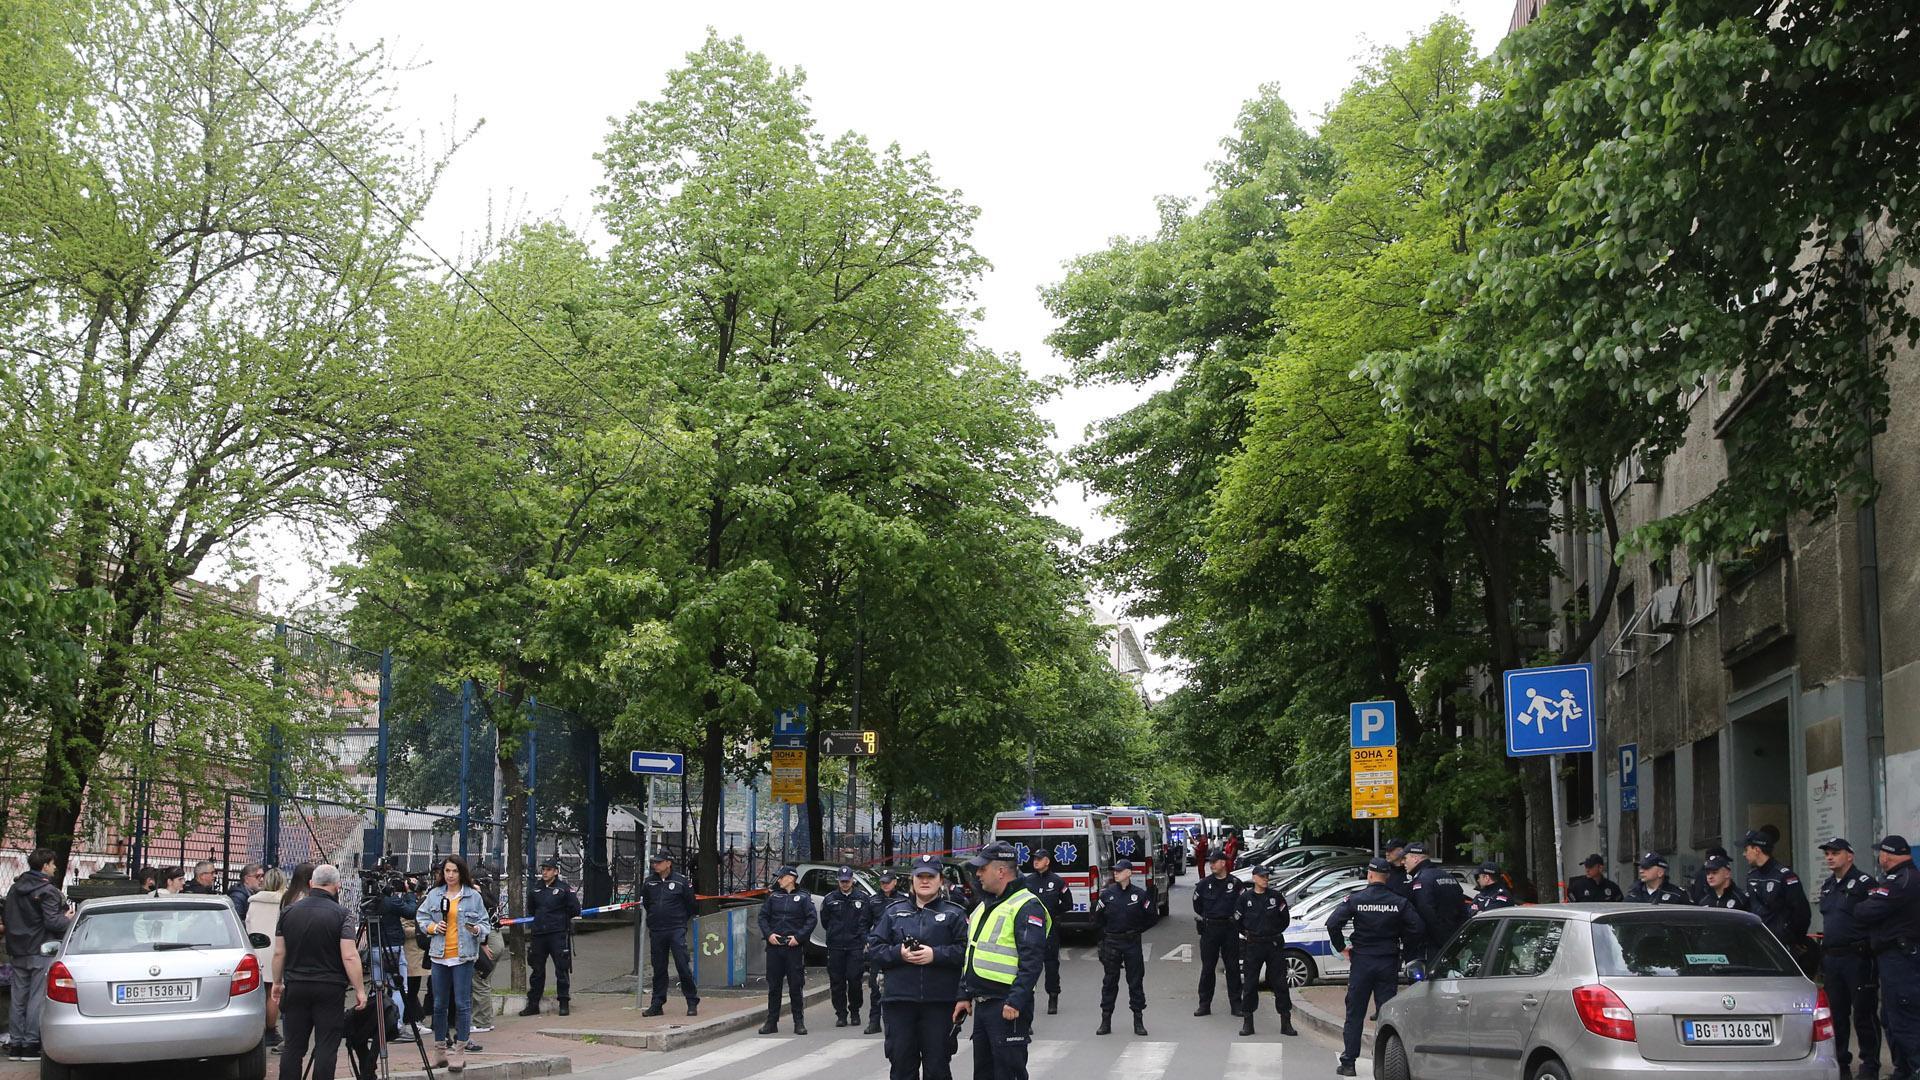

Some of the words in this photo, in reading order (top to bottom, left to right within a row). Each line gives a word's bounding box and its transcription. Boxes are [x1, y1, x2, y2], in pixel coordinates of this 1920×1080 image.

[1361, 708, 1385, 741] P
[1354, 750, 1383, 760] ЗОНА
[1387, 750, 1393, 758] 2
[1622, 750, 1634, 783] P
[1075, 819, 1084, 828] 12
[1134, 817, 1142, 825] 14
[1357, 904, 1399, 913] ПОЛИЦИЈА
[126, 986, 139, 998] BG
[1695, 1023, 1711, 1038] BG
